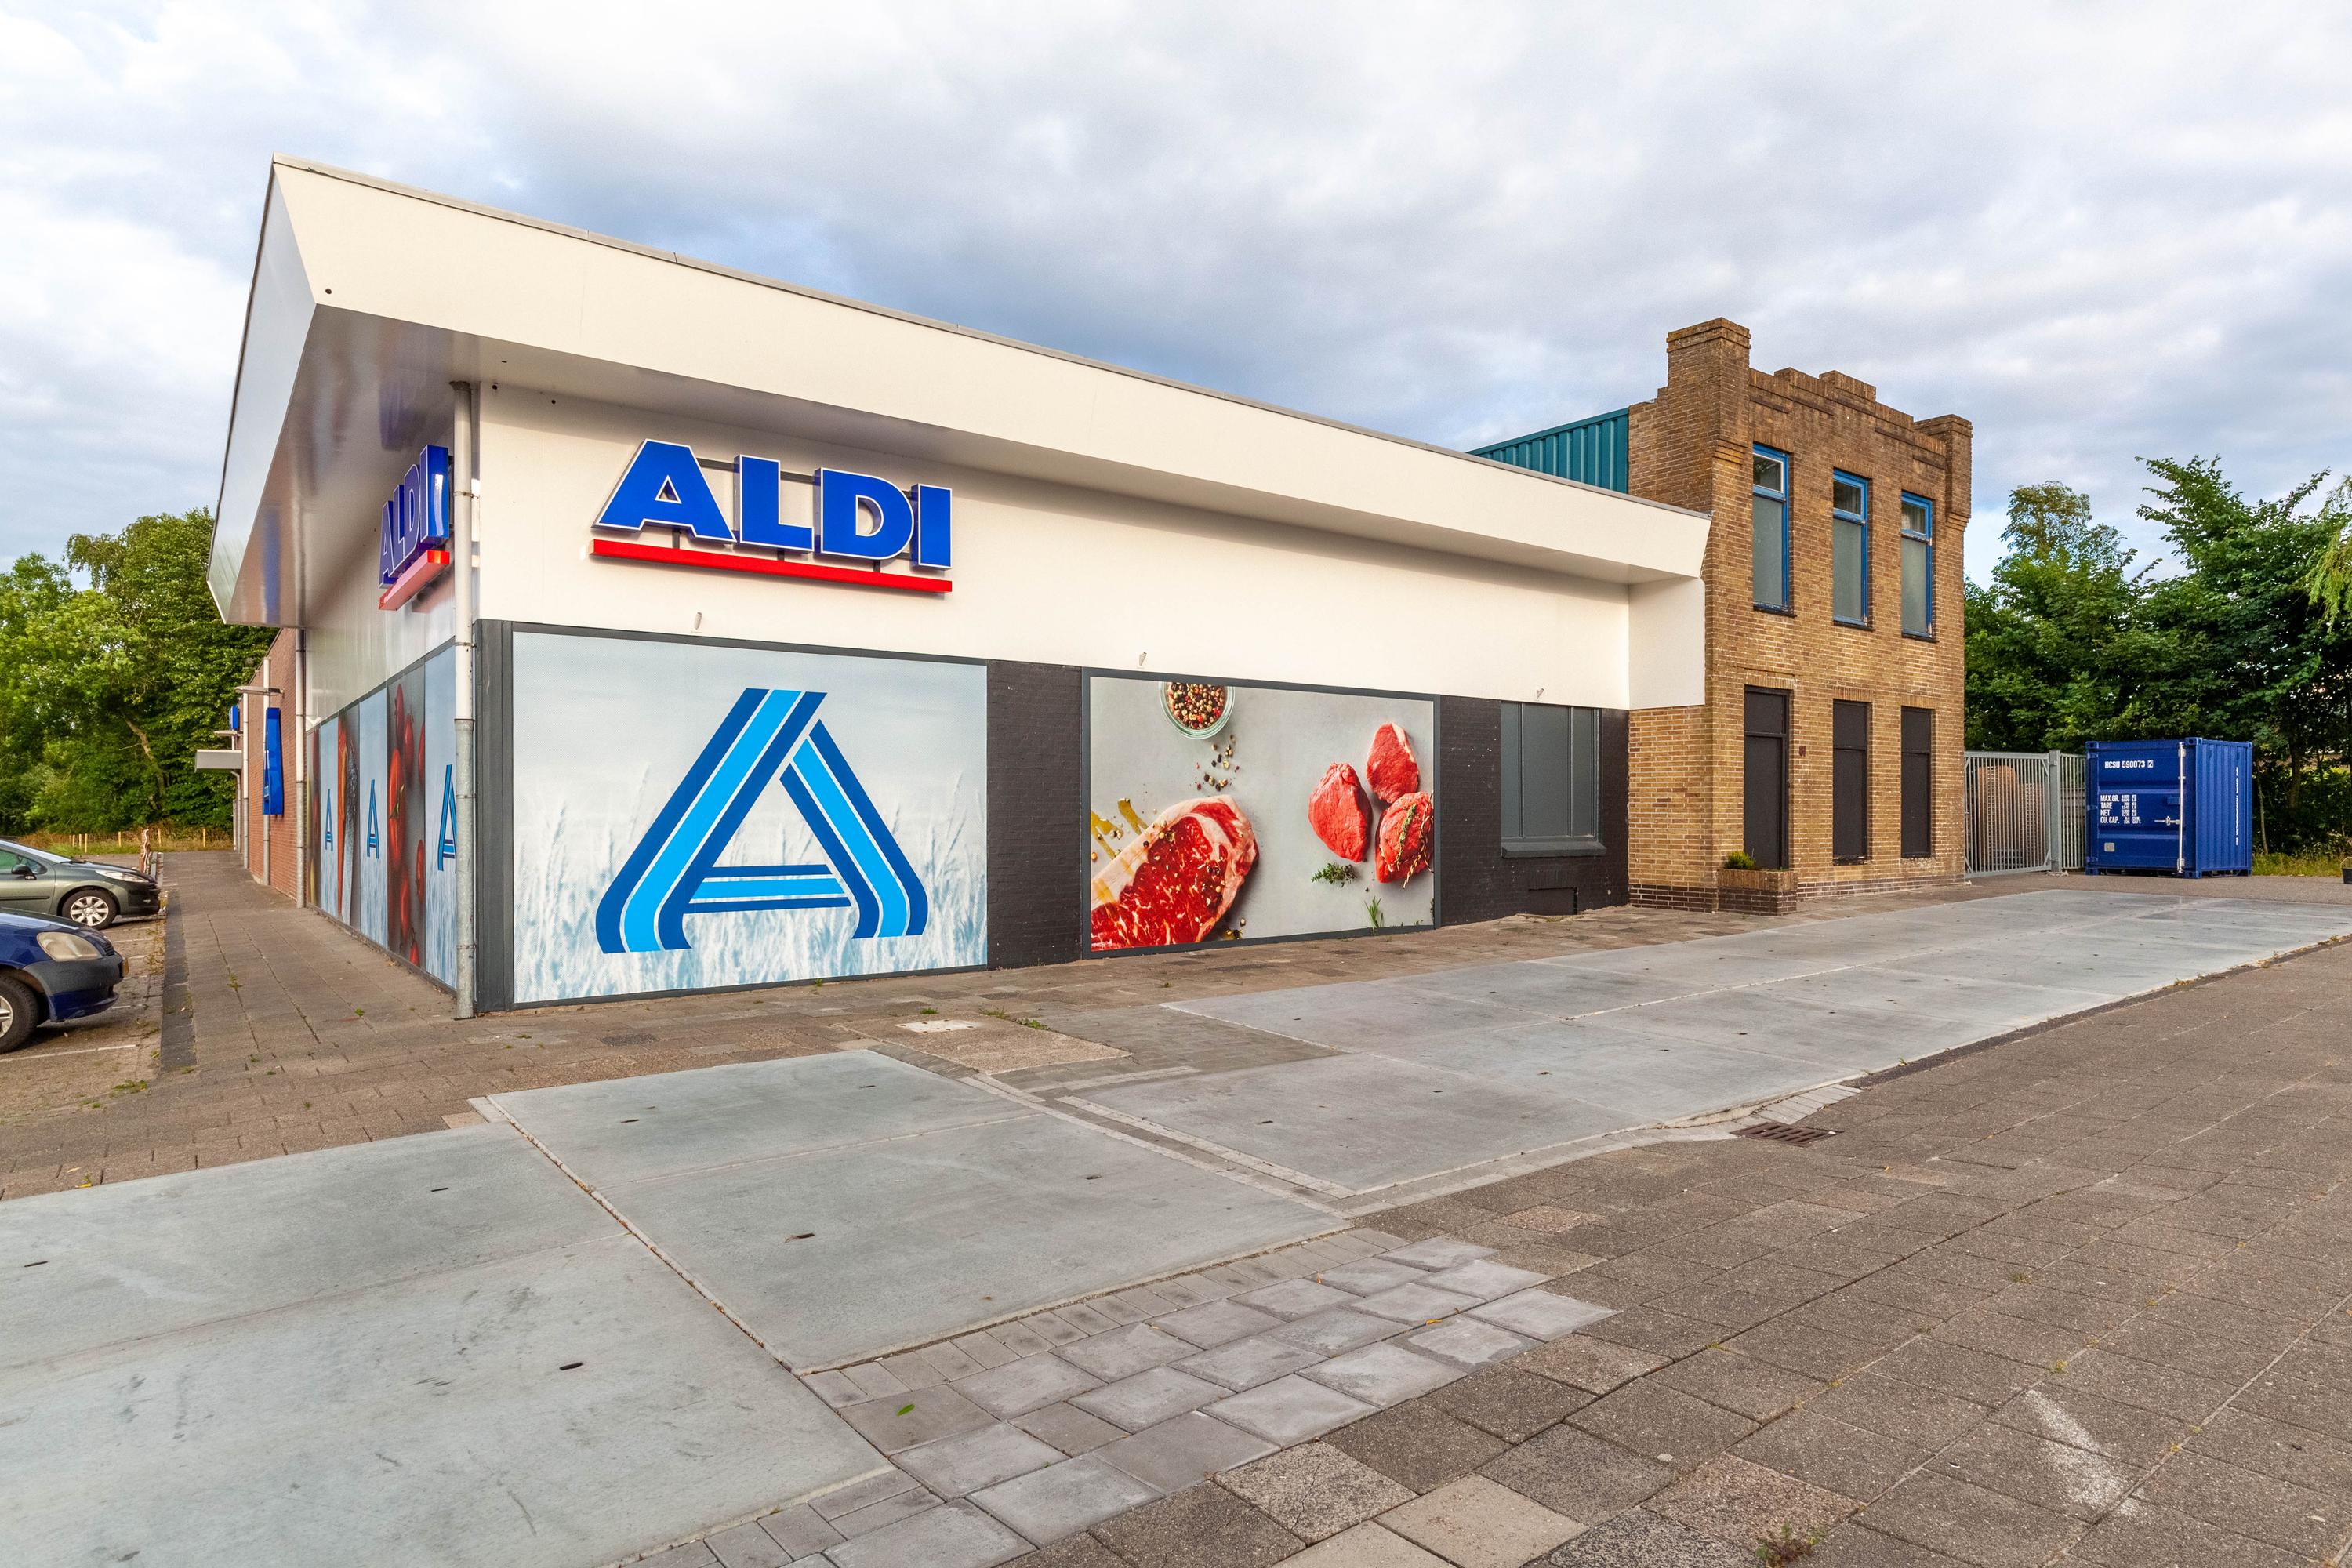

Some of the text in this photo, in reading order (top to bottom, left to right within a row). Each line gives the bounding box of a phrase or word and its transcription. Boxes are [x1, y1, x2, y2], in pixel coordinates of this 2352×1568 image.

[379, 445, 428, 588] ALDI
[592, 439, 952, 570] ALDI
[2147, 760, 2154, 768] 2
